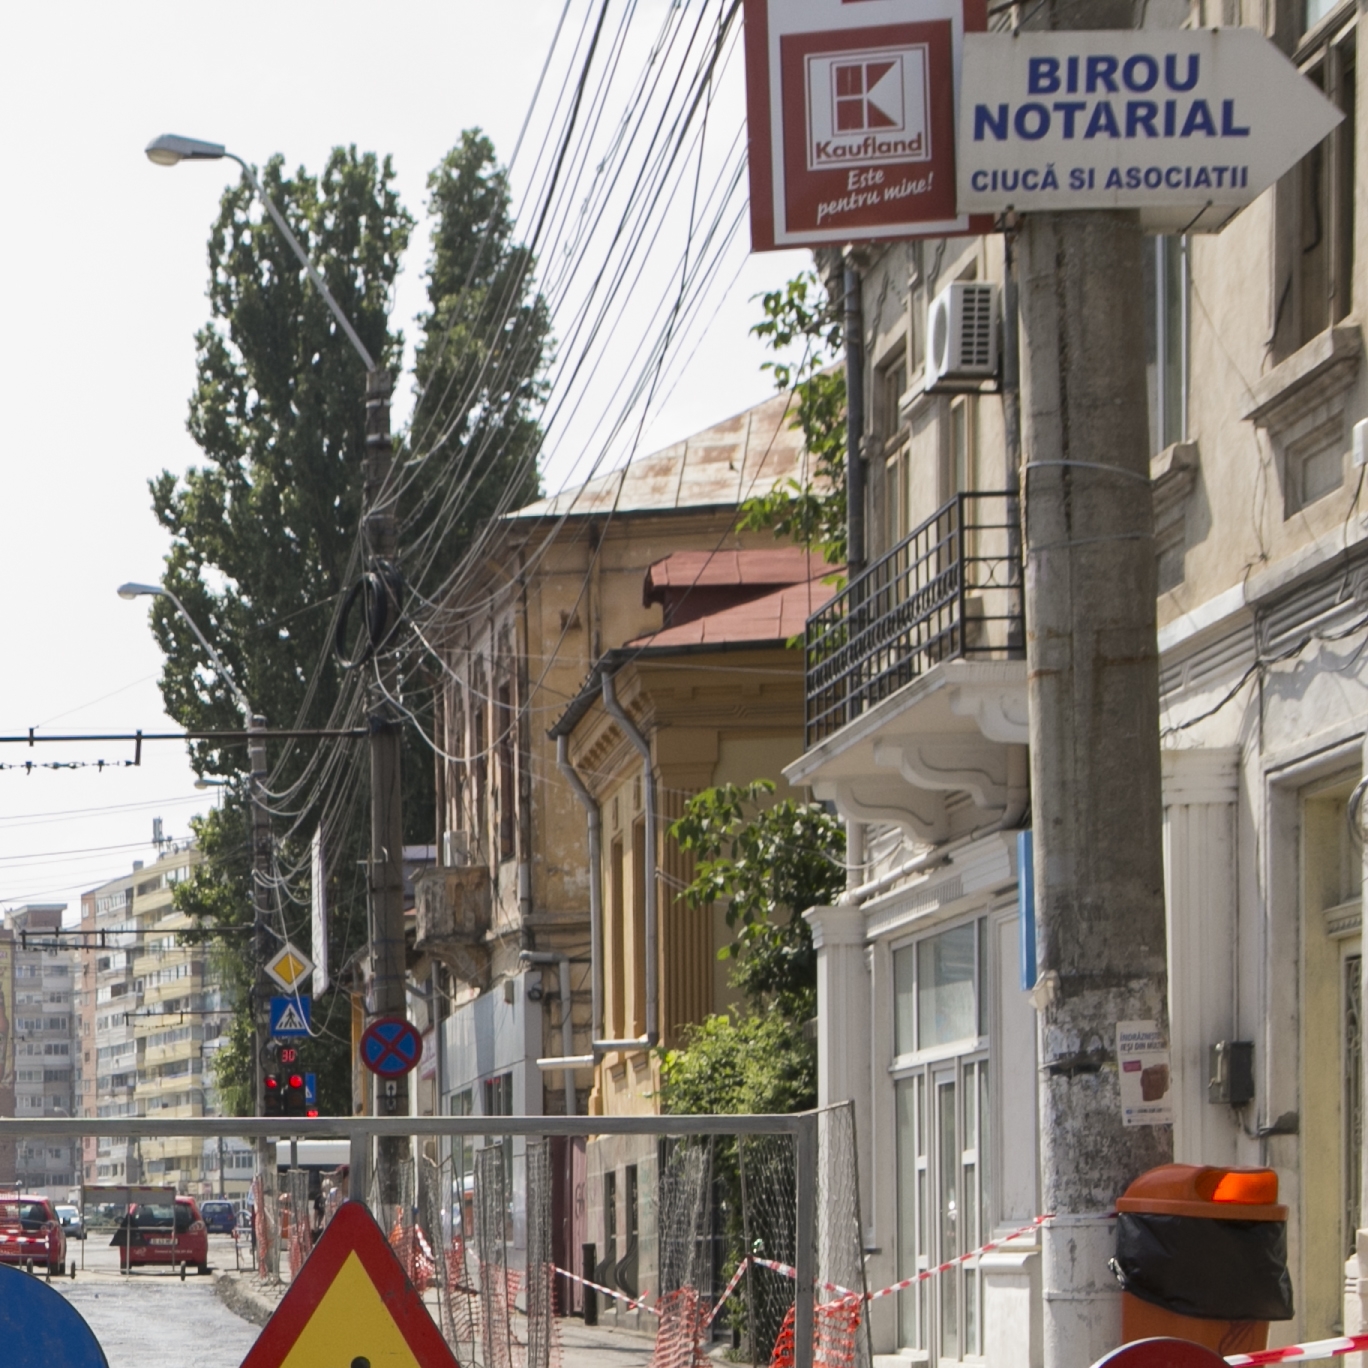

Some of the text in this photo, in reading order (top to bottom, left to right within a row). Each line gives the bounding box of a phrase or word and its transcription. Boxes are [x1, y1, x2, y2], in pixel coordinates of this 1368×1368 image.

[1027, 53, 1201, 95] BIROU
[973, 98, 1251, 141] NOTARIAL
[816, 132, 922, 159] Kaufland
[847, 168, 884, 191] Este
[971, 162, 1249, 192] CIUCĂ SI ASOCIATII
[817, 171, 934, 225] pentru mine!
